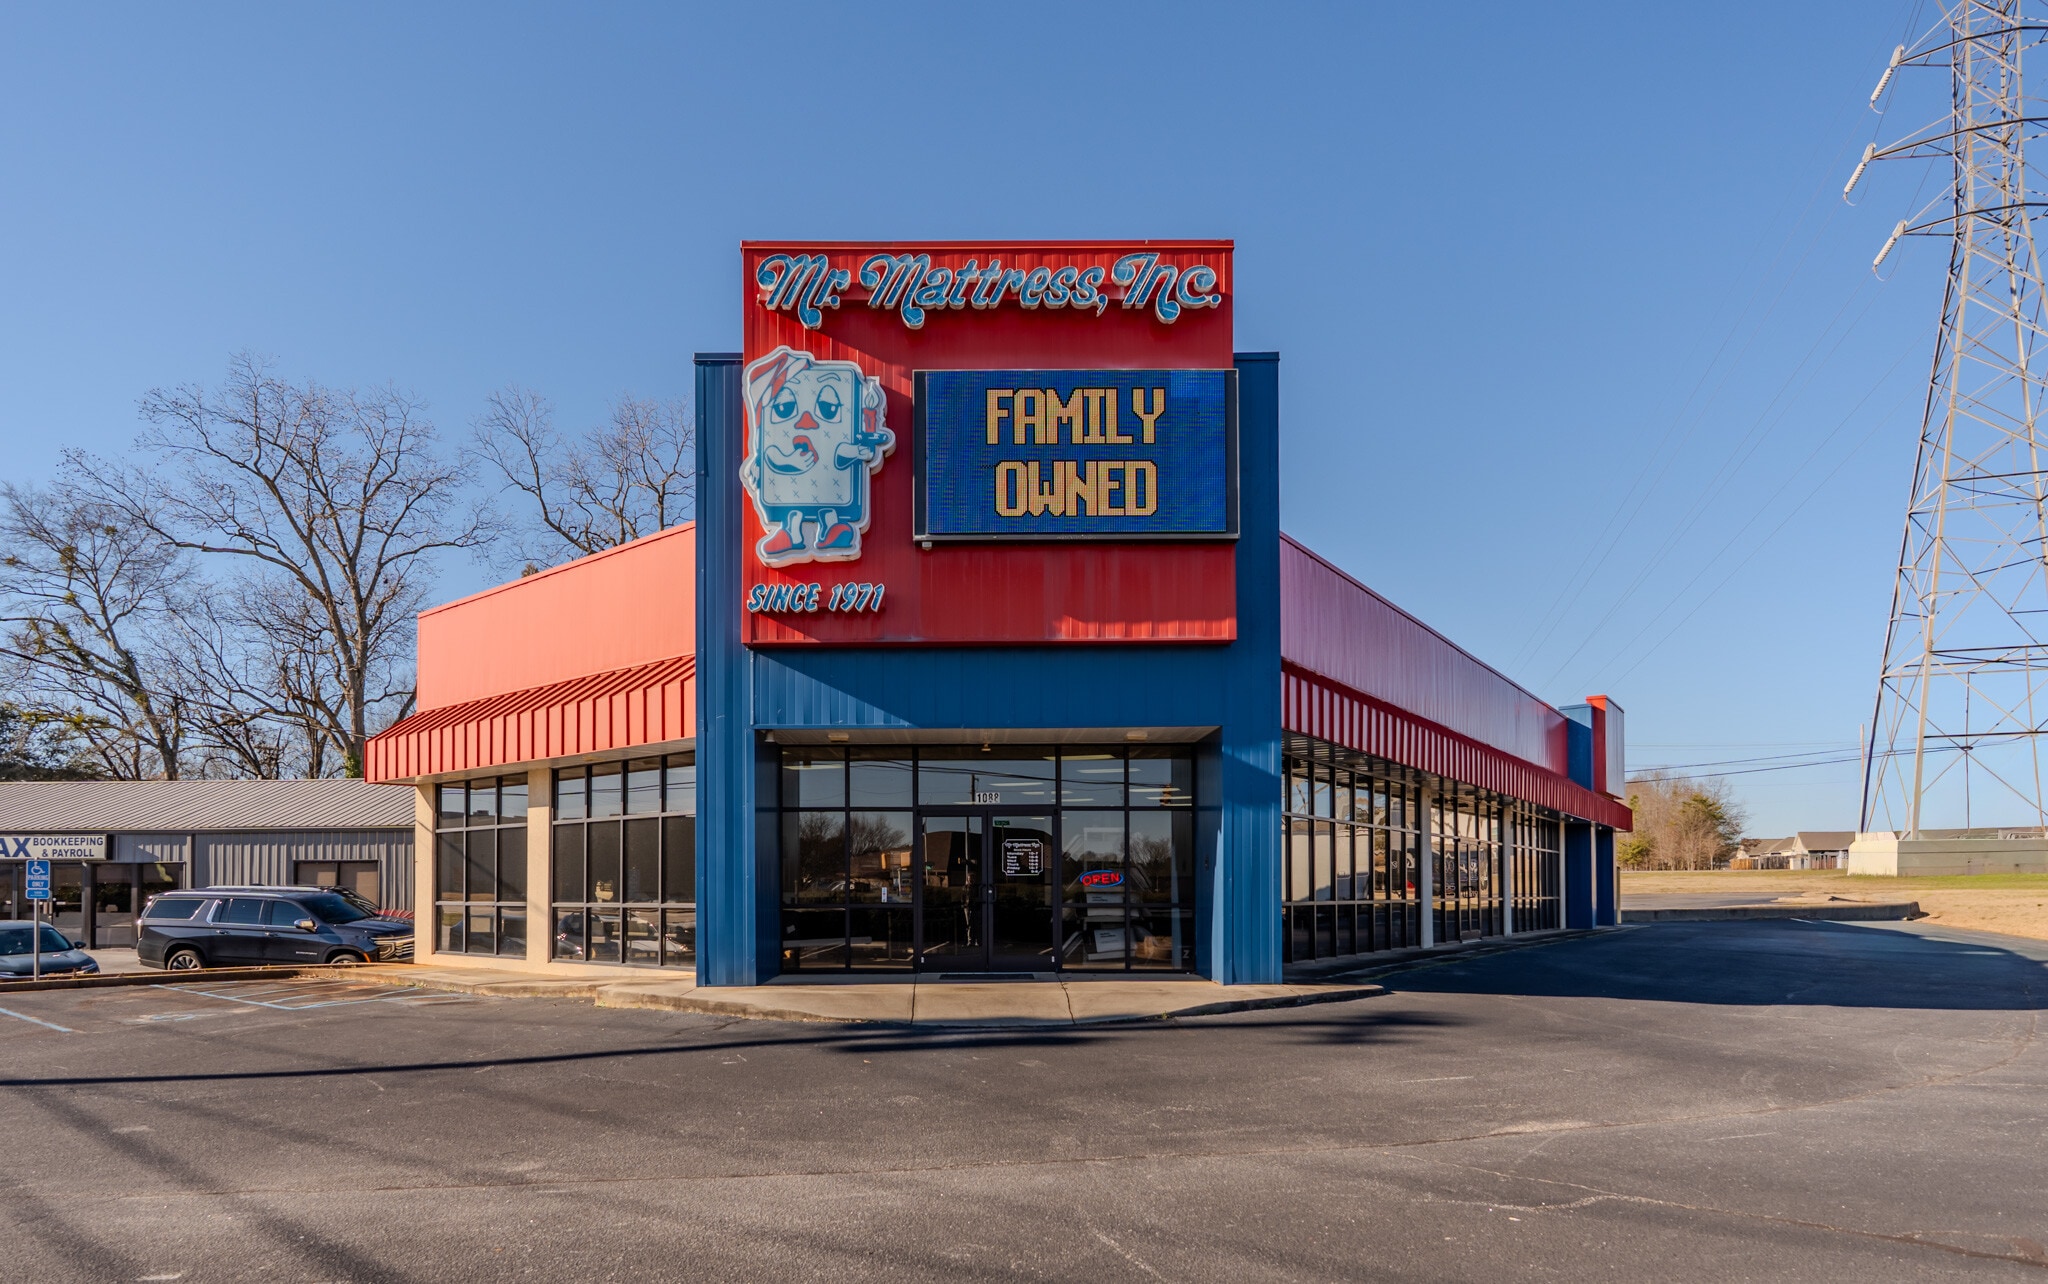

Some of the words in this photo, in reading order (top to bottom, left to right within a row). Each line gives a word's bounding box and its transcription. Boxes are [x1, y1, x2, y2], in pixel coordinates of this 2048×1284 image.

[756, 253, 851, 329] Mr.
[859, 253, 1108, 329] Mattress,
[1111, 252, 1221, 324] Inc.
[986, 387, 1165, 445] FAMILY
[994, 460, 1158, 517] OWNED
[747, 583, 821, 614] SINCE
[826, 583, 885, 613] 1971
[33, 837, 103, 846] BOOKKEEPING
[42, 849, 48, 857] &
[52, 849, 94, 857] PAYROLL
[1082, 872, 1120, 887] OPEN
